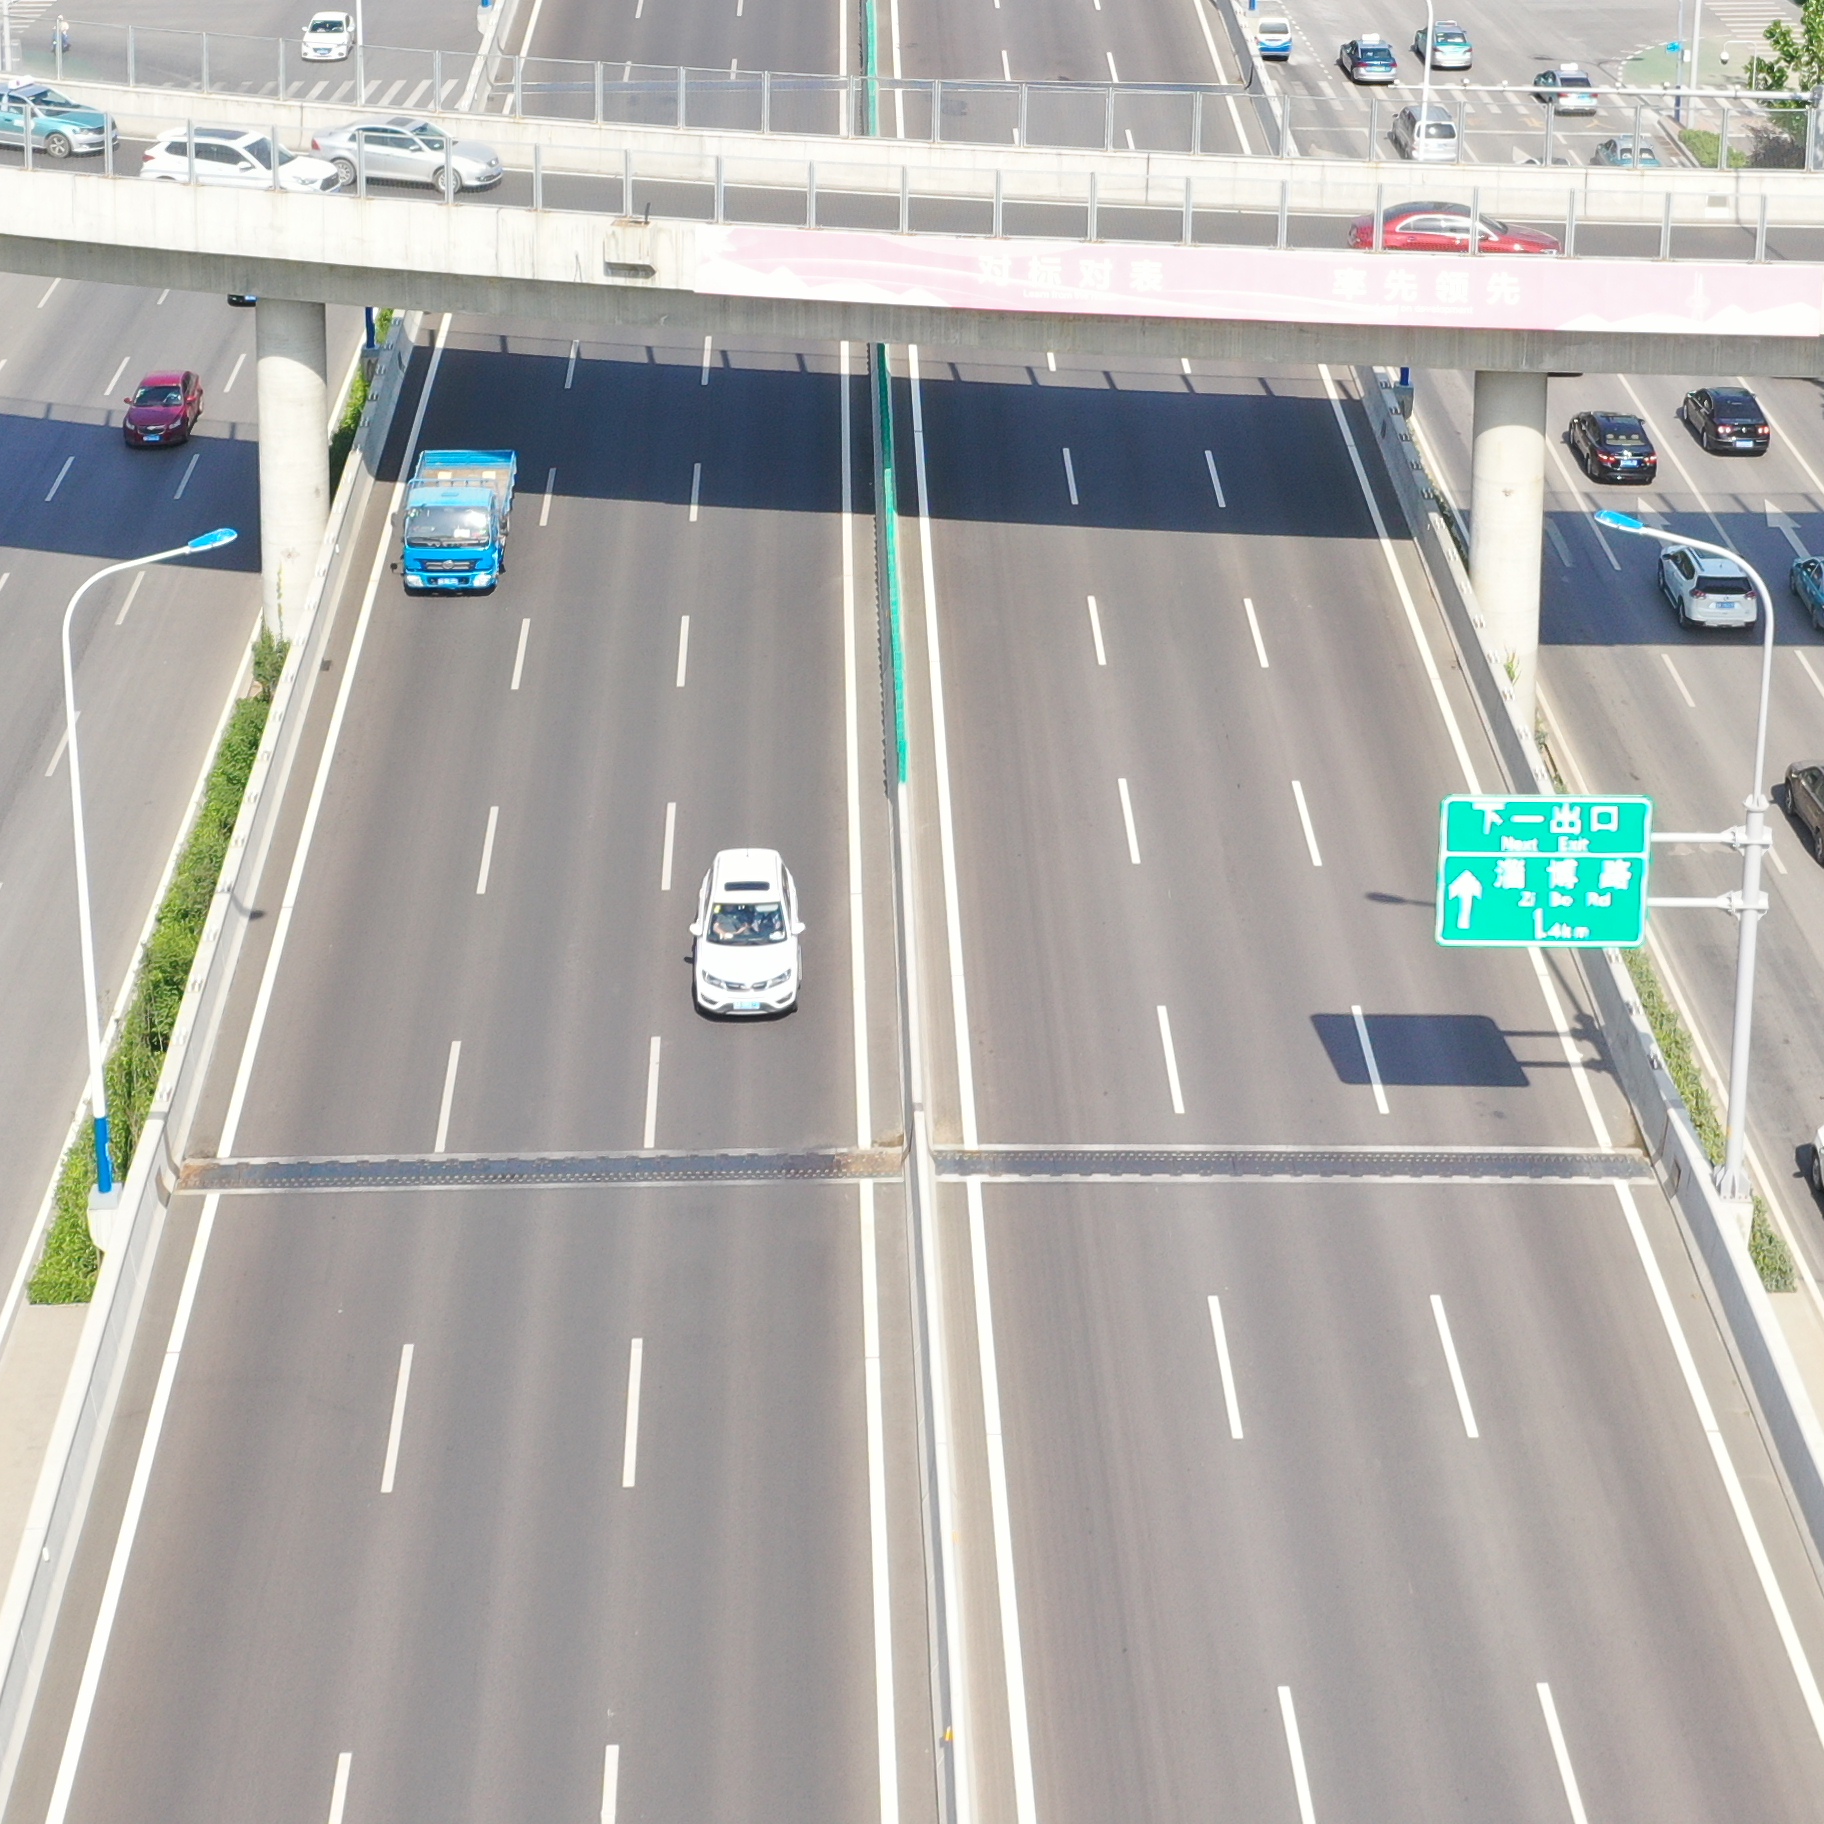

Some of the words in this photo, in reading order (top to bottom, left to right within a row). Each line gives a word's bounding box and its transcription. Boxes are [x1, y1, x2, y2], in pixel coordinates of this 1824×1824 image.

[977, 254, 1164, 292] 对标对表
[1331, 267, 1521, 305] 率先领先
[1472, 801, 1619, 835] 下一出口
[1501, 836, 1538, 852] Next
[1557, 836, 1590, 852] Exit
[1518, 891, 1537, 908] Zi
[1549, 891, 1574, 908] Bo
[1585, 891, 1612, 908] Rd
